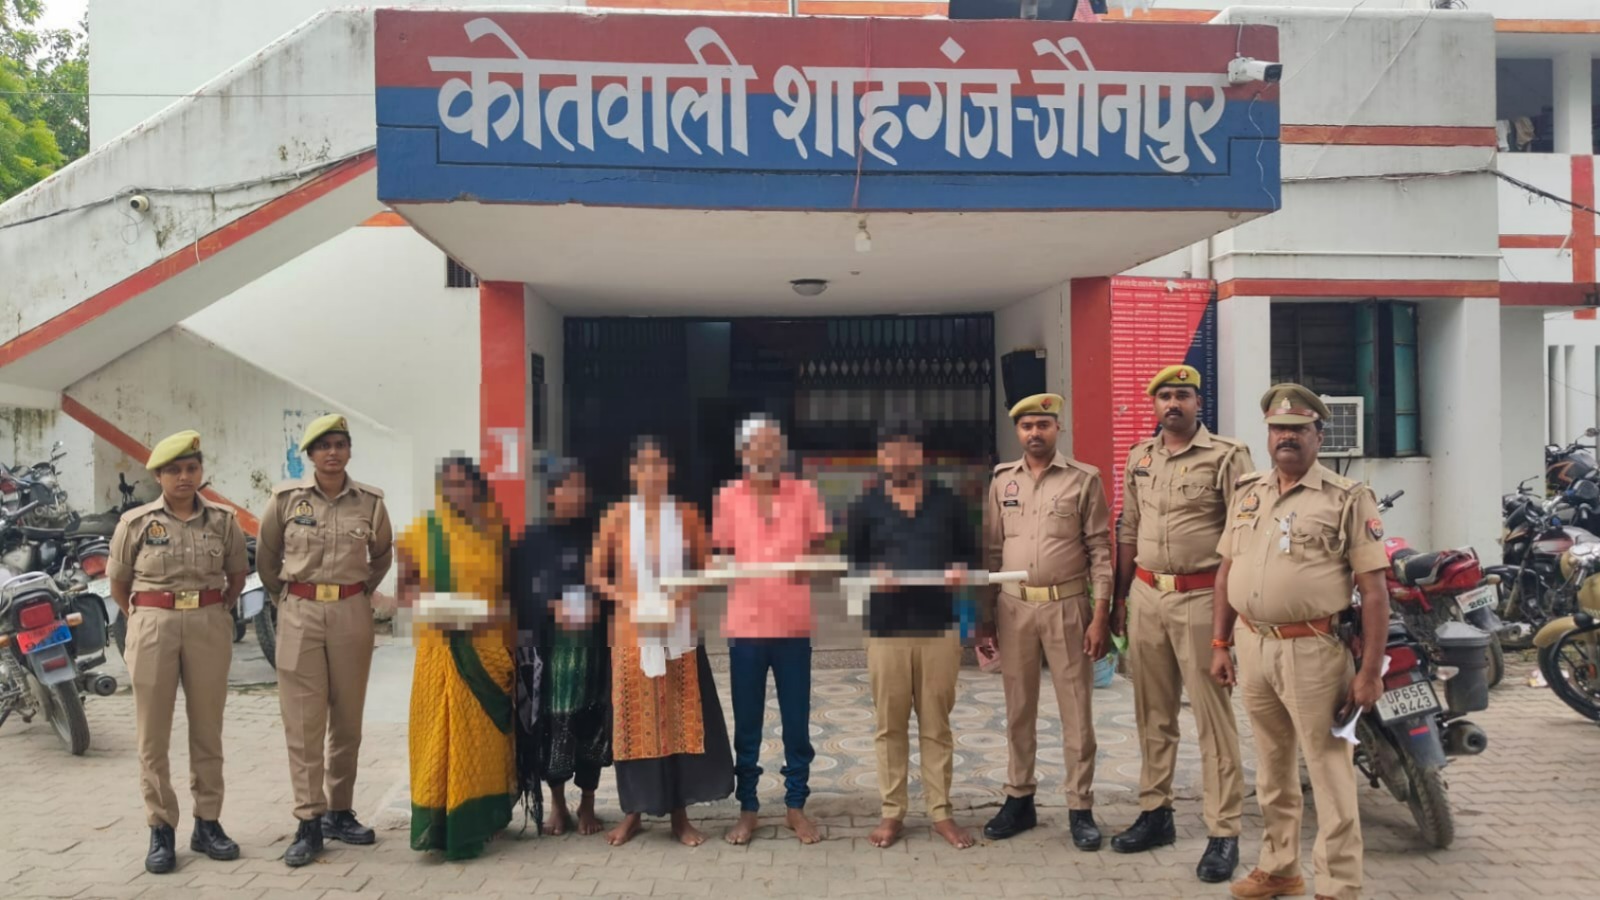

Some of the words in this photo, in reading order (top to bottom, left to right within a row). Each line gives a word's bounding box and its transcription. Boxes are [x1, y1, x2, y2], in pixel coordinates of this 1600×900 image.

[428, 18, 757, 157] कोतवाली
[773, 38, 1229, 173] शाहगंज-जौनपुर
[1385, 684, 1427, 704] UP65E
